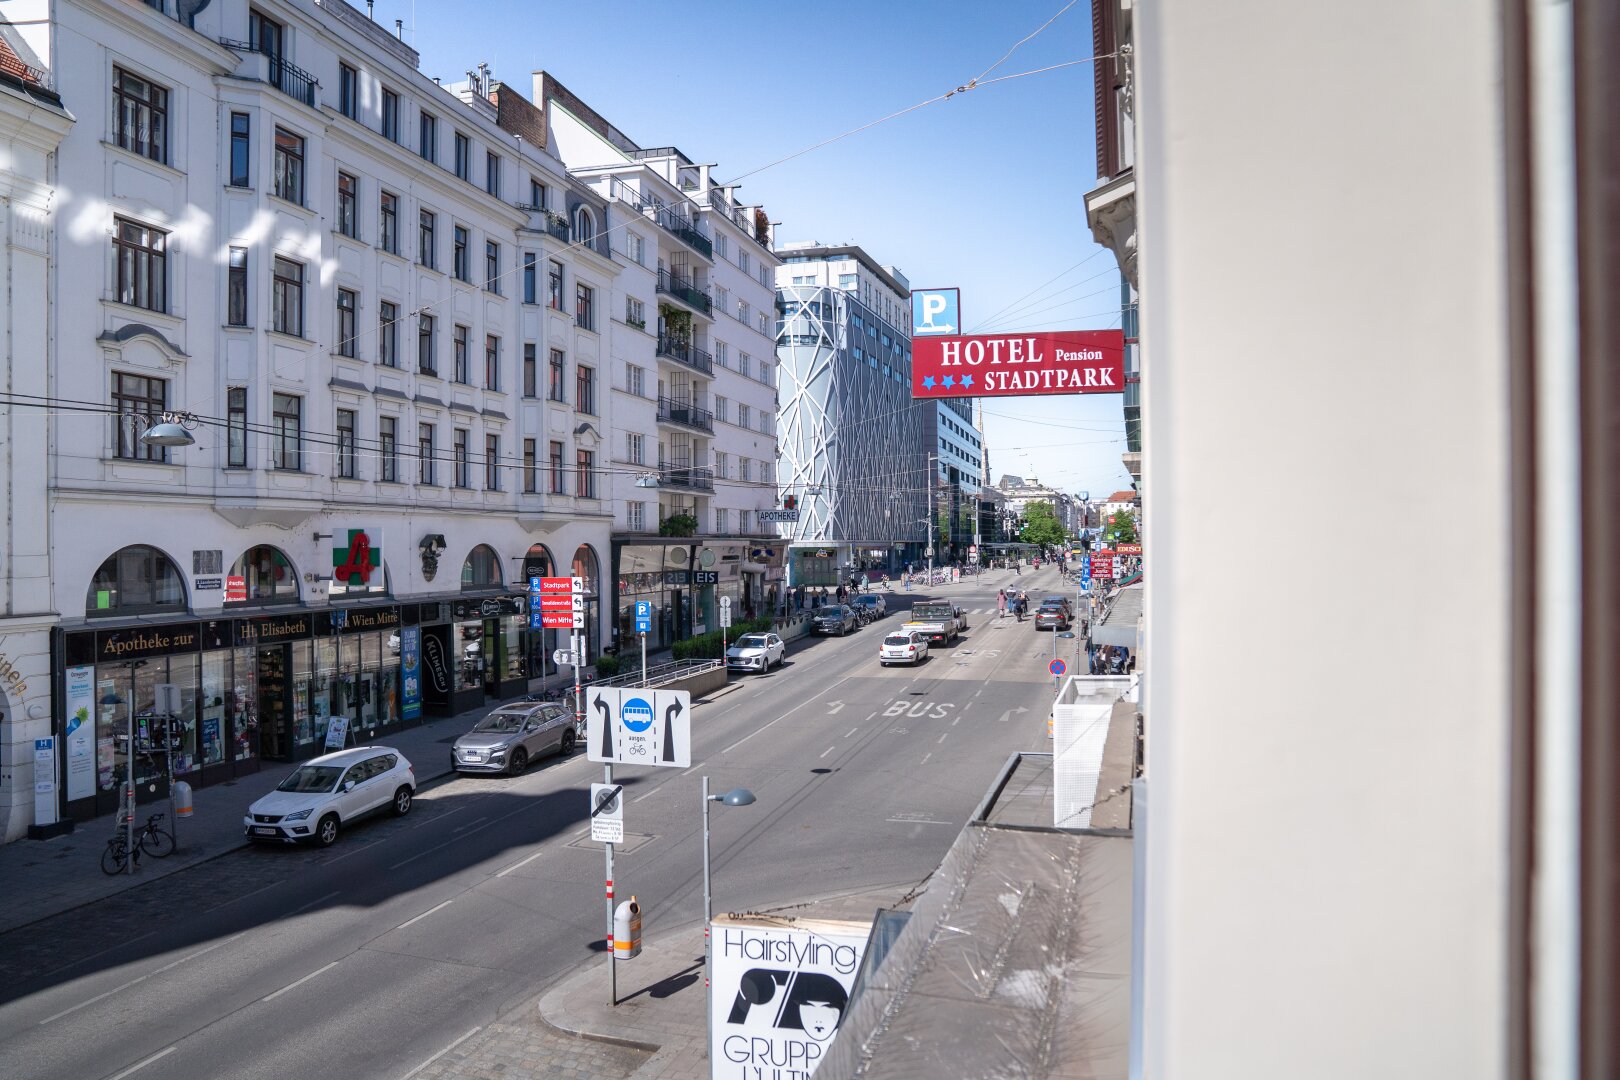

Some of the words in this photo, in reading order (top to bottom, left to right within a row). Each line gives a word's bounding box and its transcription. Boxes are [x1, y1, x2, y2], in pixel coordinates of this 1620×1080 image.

[940, 338, 1043, 366] HOTEL
[1055, 348, 1103, 362] Pension
[984, 367, 1116, 391] STADTPARK
[760, 511, 796, 521] APOTHEKE
[543, 582, 570, 590] Stadtpark
[696, 572, 715, 583] EIS
[262, 620, 306, 637] Elisabeth
[352, 614, 375, 627] Wien
[376, 612, 399, 625] Mitte
[558, 616, 573, 624] Mitte
[103, 633, 170, 655] Apotheke
[173, 634, 194, 646] zur
[426, 640, 446, 687] KLIMESCH
[881, 700, 956, 719] BUS
[628, 735, 647, 743] ausgen.
[724, 928, 857, 975] Hairstyling
[723, 1035, 832, 1069] GRUPP
